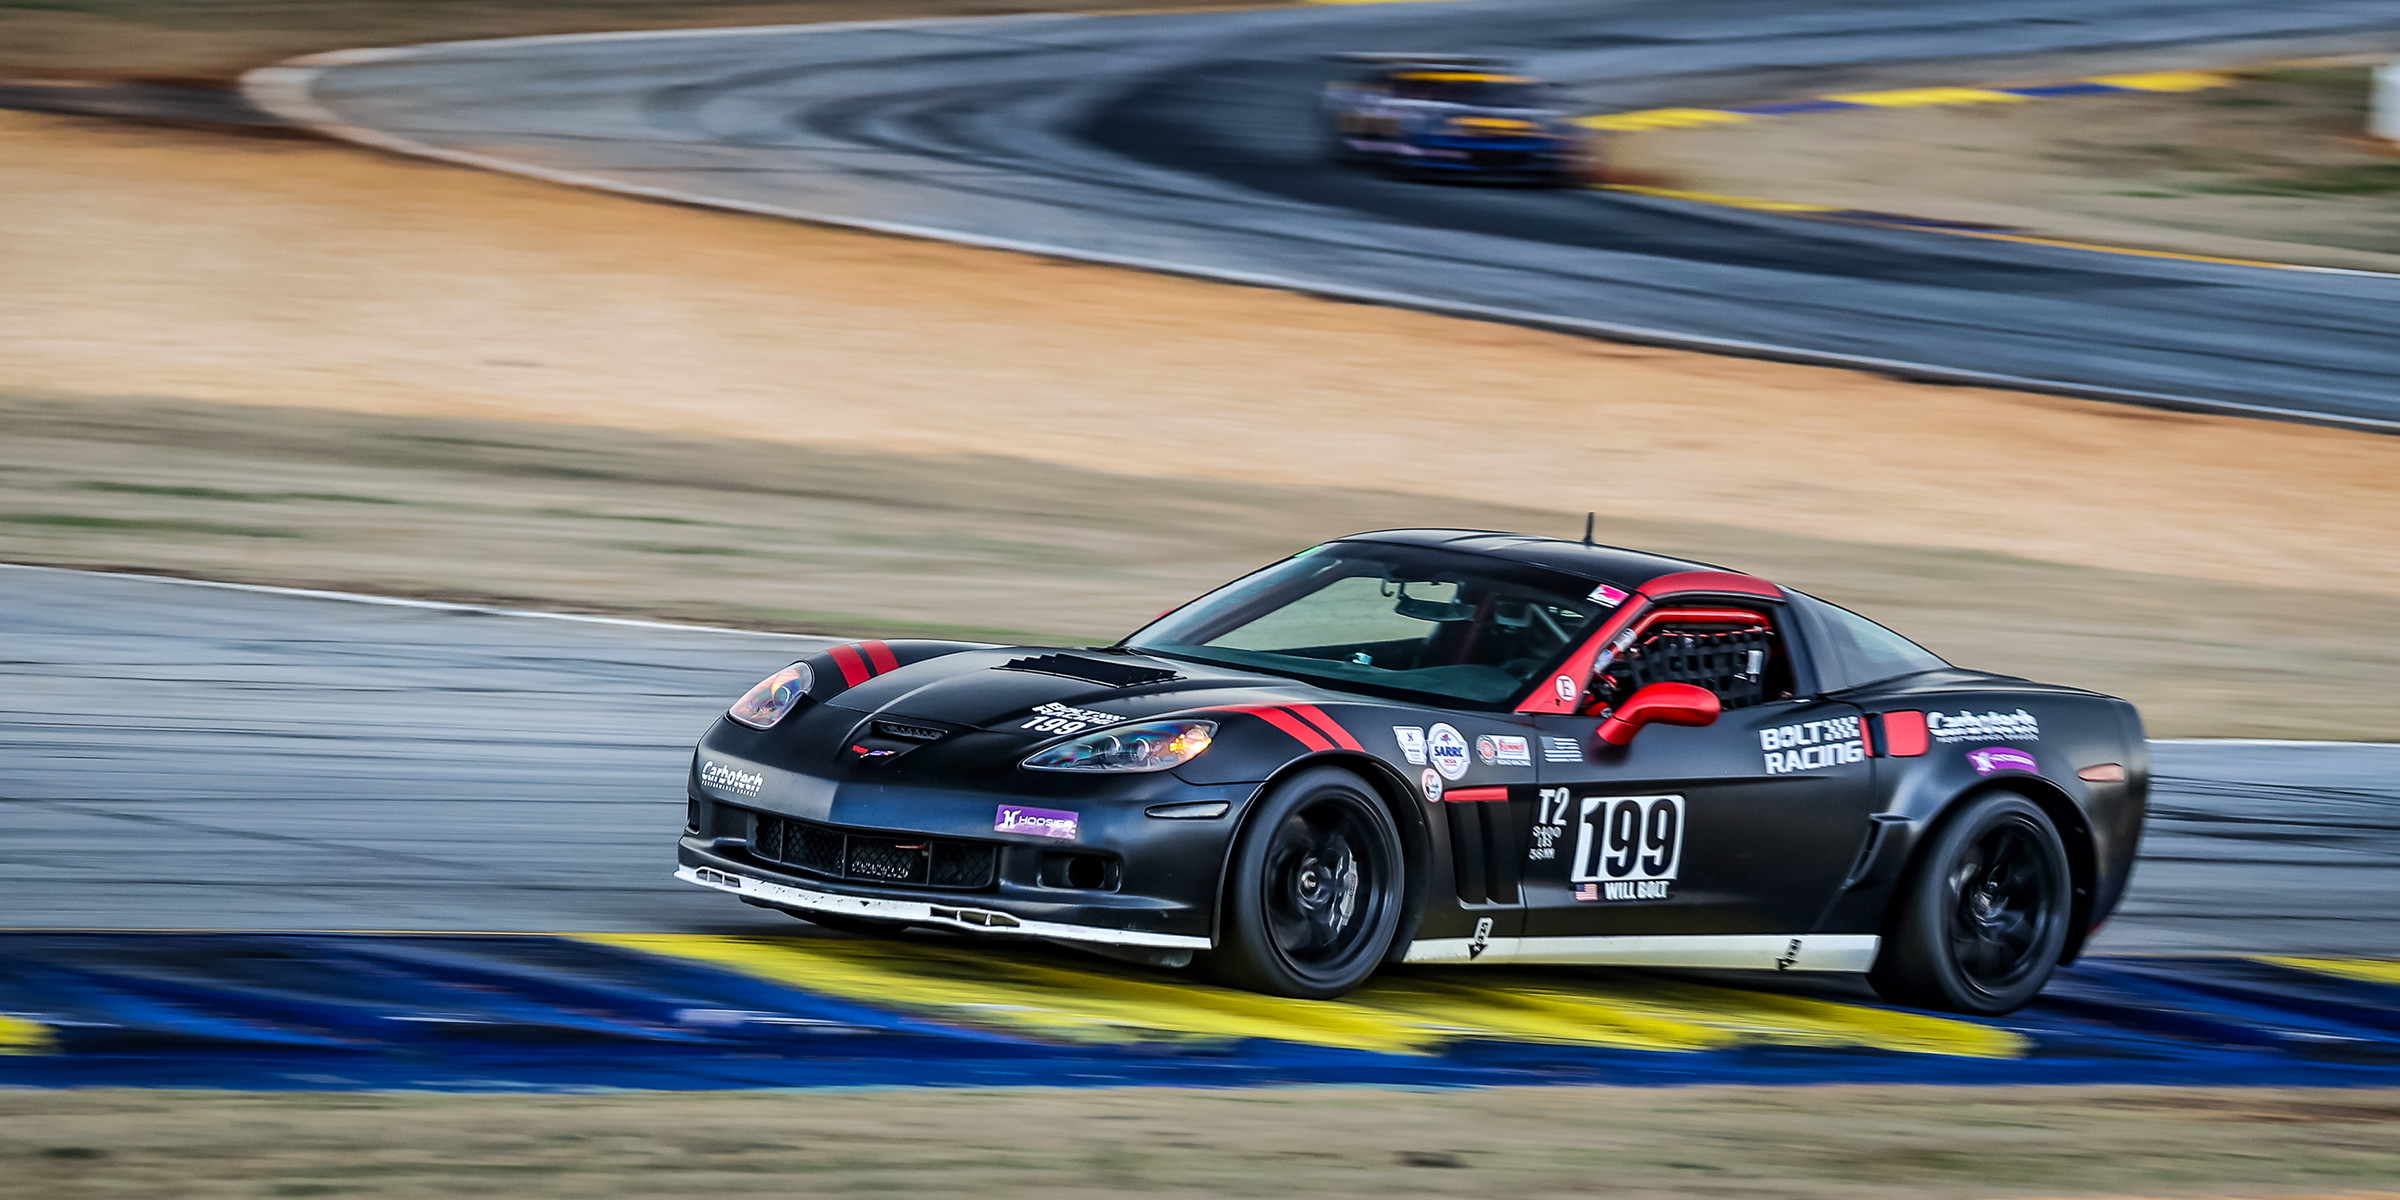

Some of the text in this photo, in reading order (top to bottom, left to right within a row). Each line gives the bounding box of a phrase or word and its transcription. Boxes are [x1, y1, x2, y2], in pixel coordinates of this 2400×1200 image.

[1020, 716, 1087, 735] 199
[1759, 721, 1823, 751] BOLT
[1763, 740, 1865, 775] RACING
[702, 760, 764, 792] Carbotech
[1018, 815, 1075, 828] HOOSIER
[1538, 786, 1570, 826] T2
[1583, 798, 1678, 878] 199
[1604, 880, 1670, 900] WILL BOLT
